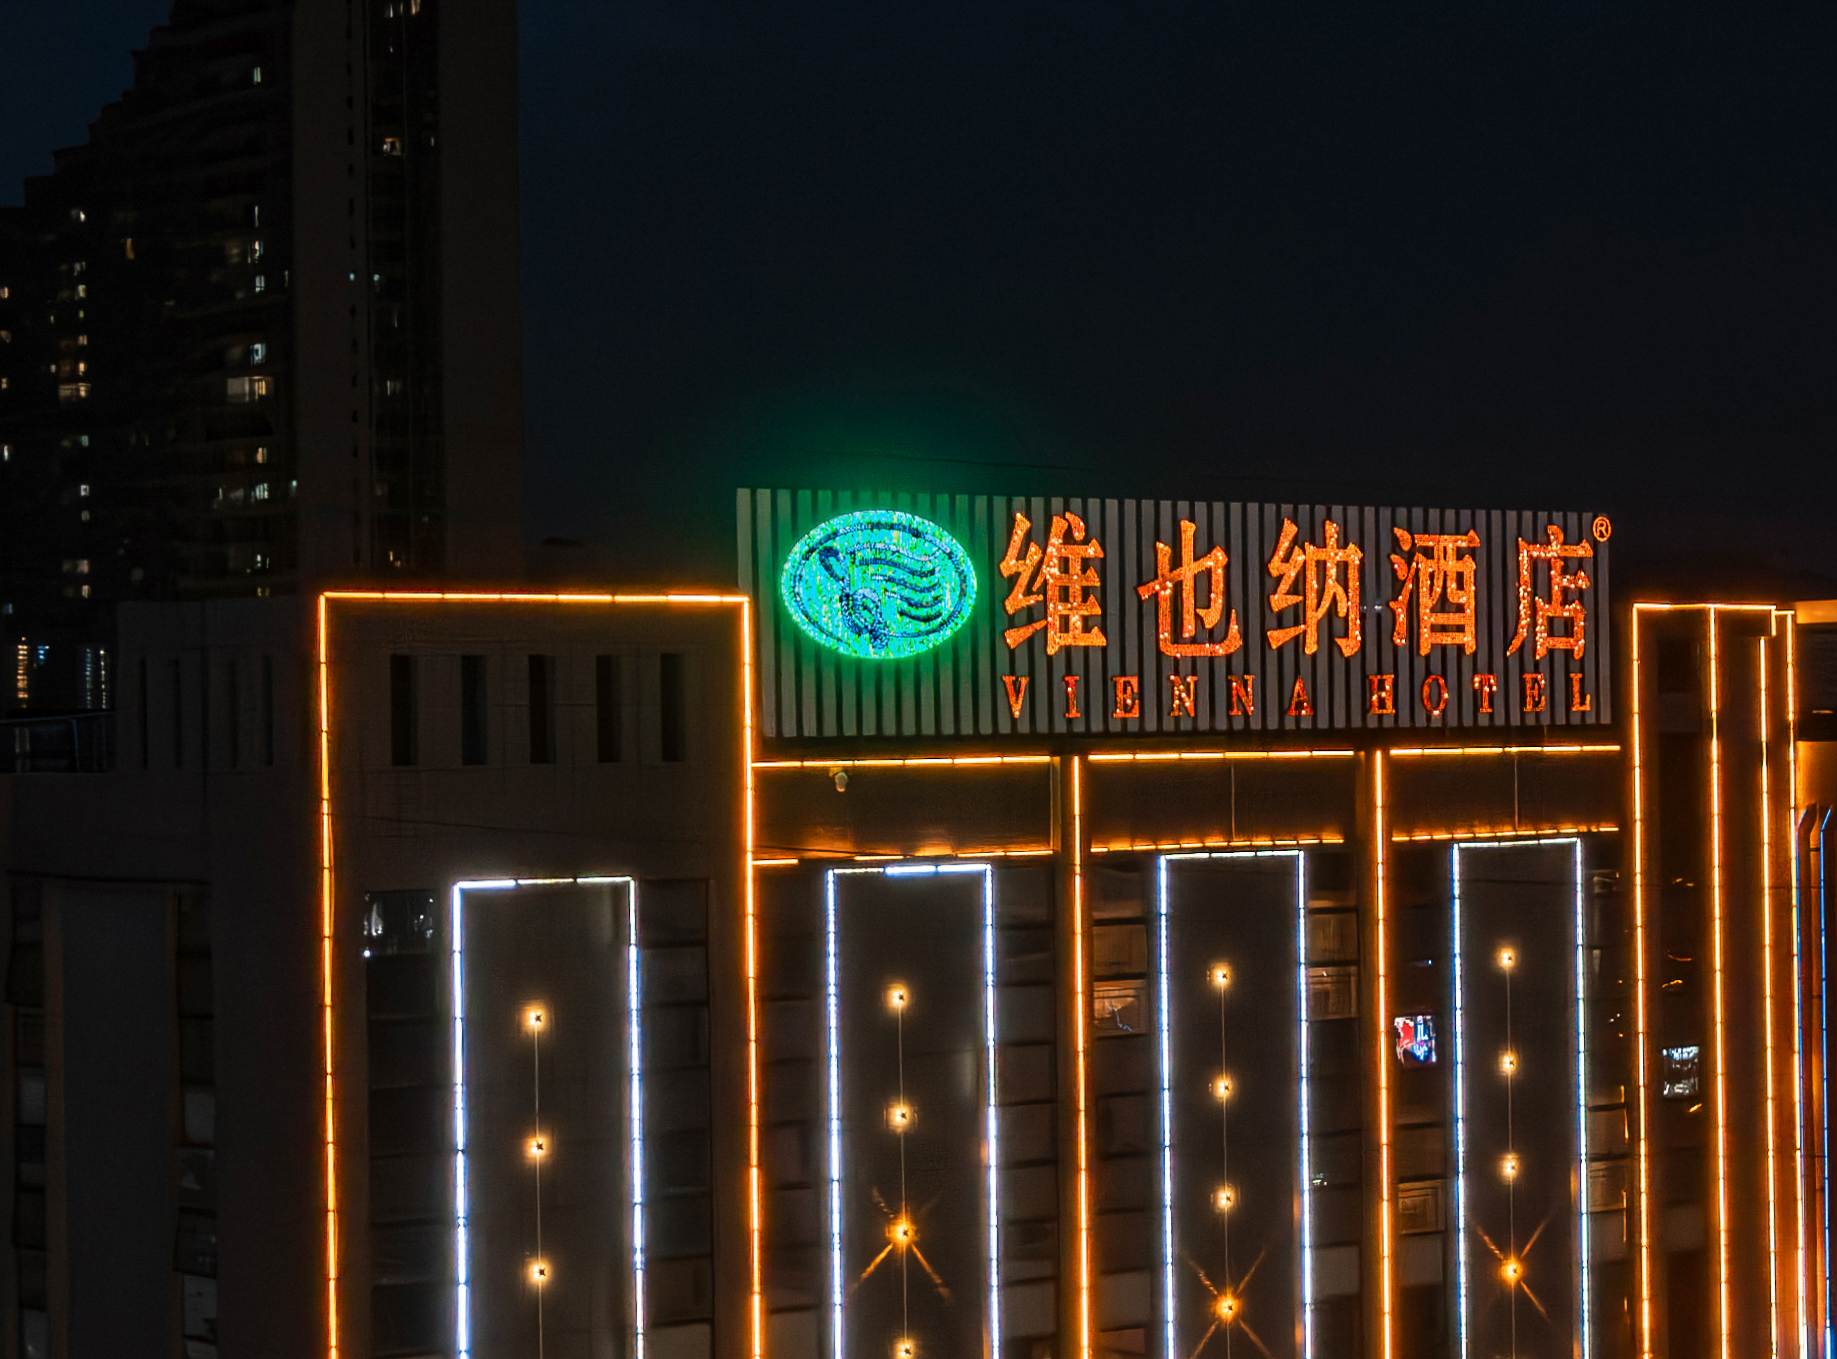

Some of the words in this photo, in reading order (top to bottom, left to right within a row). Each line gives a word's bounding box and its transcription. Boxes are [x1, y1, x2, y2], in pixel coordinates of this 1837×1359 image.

[999, 511, 1594, 660] 维也纳酒店
[1002, 673, 1314, 719] VIENNA
[1368, 672, 1592, 717] HOTEL
